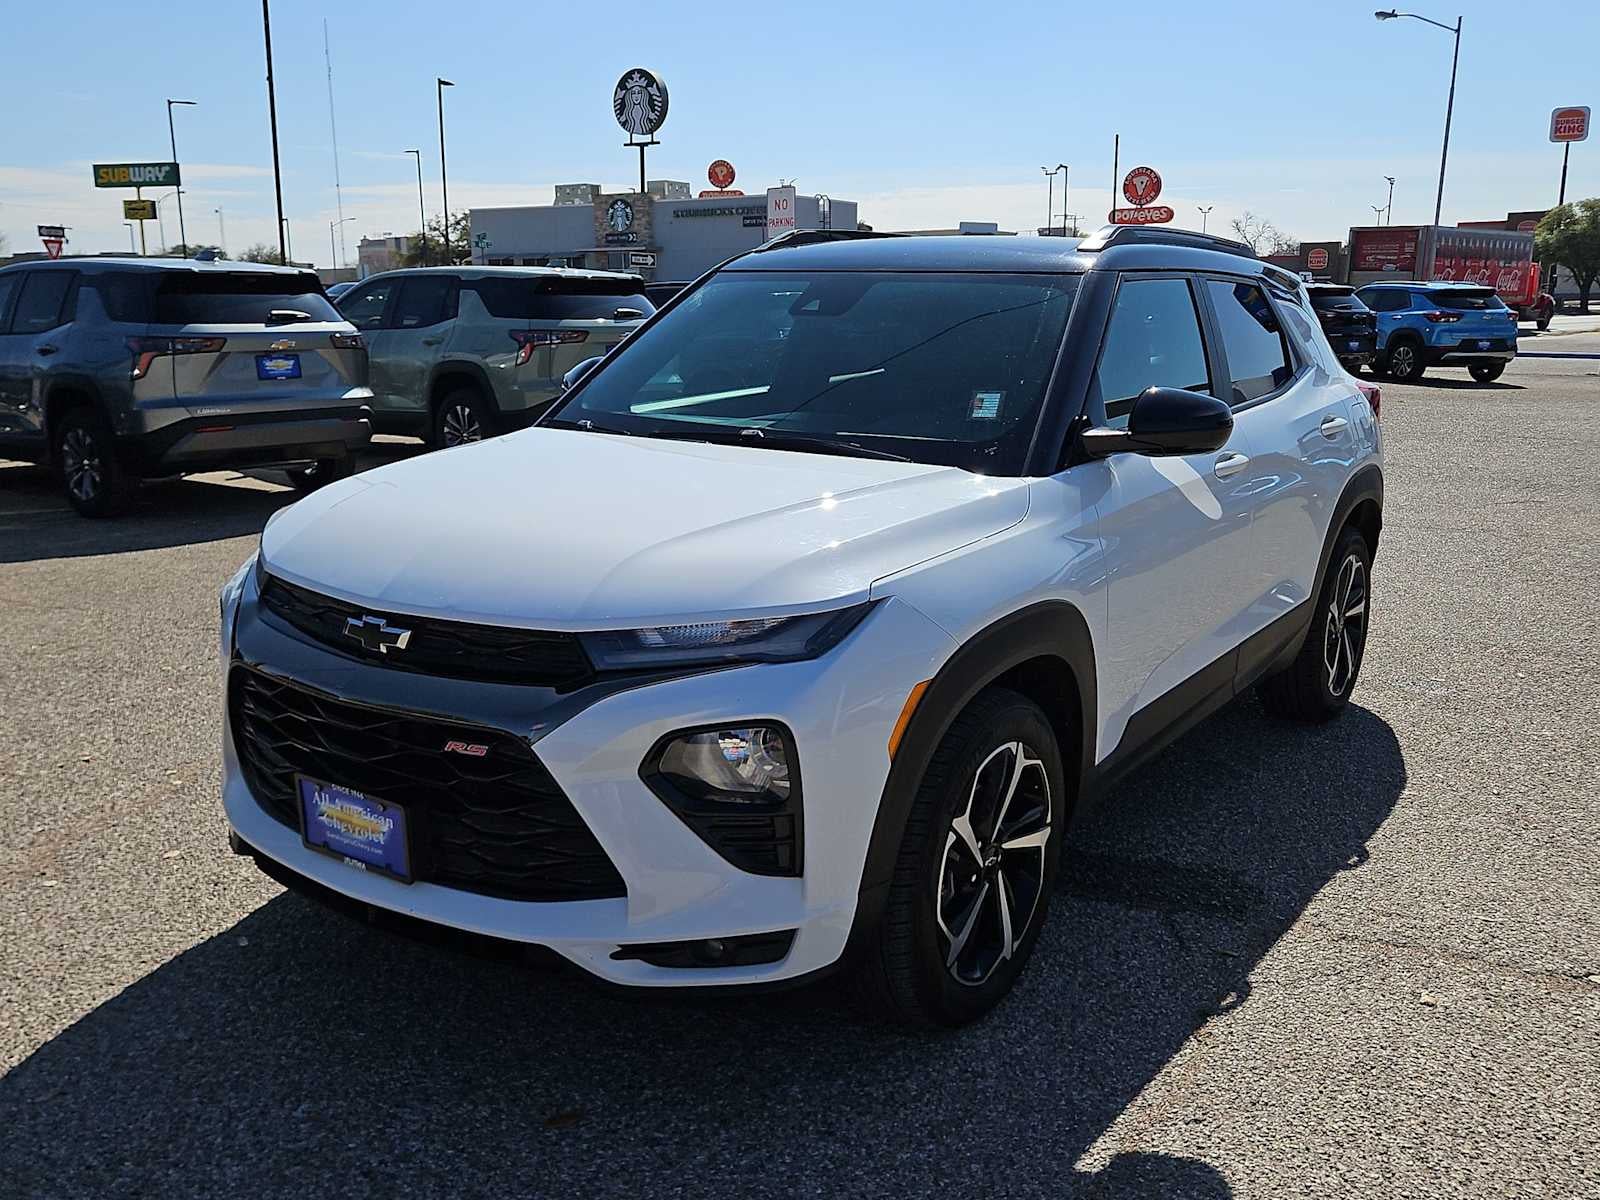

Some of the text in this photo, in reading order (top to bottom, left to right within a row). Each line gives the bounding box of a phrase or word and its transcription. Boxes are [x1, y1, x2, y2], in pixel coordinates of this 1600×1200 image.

[1554, 124, 1585, 134] KING
[98, 166, 170, 183] SUBWAY
[1125, 168, 1158, 185] LOUISIANA
[774, 199, 788, 210] NO
[768, 217, 795, 229] PARKING
[444, 741, 488, 756] RS
[312, 791, 394, 830] All American
[322, 812, 385, 845] Chevrolet
